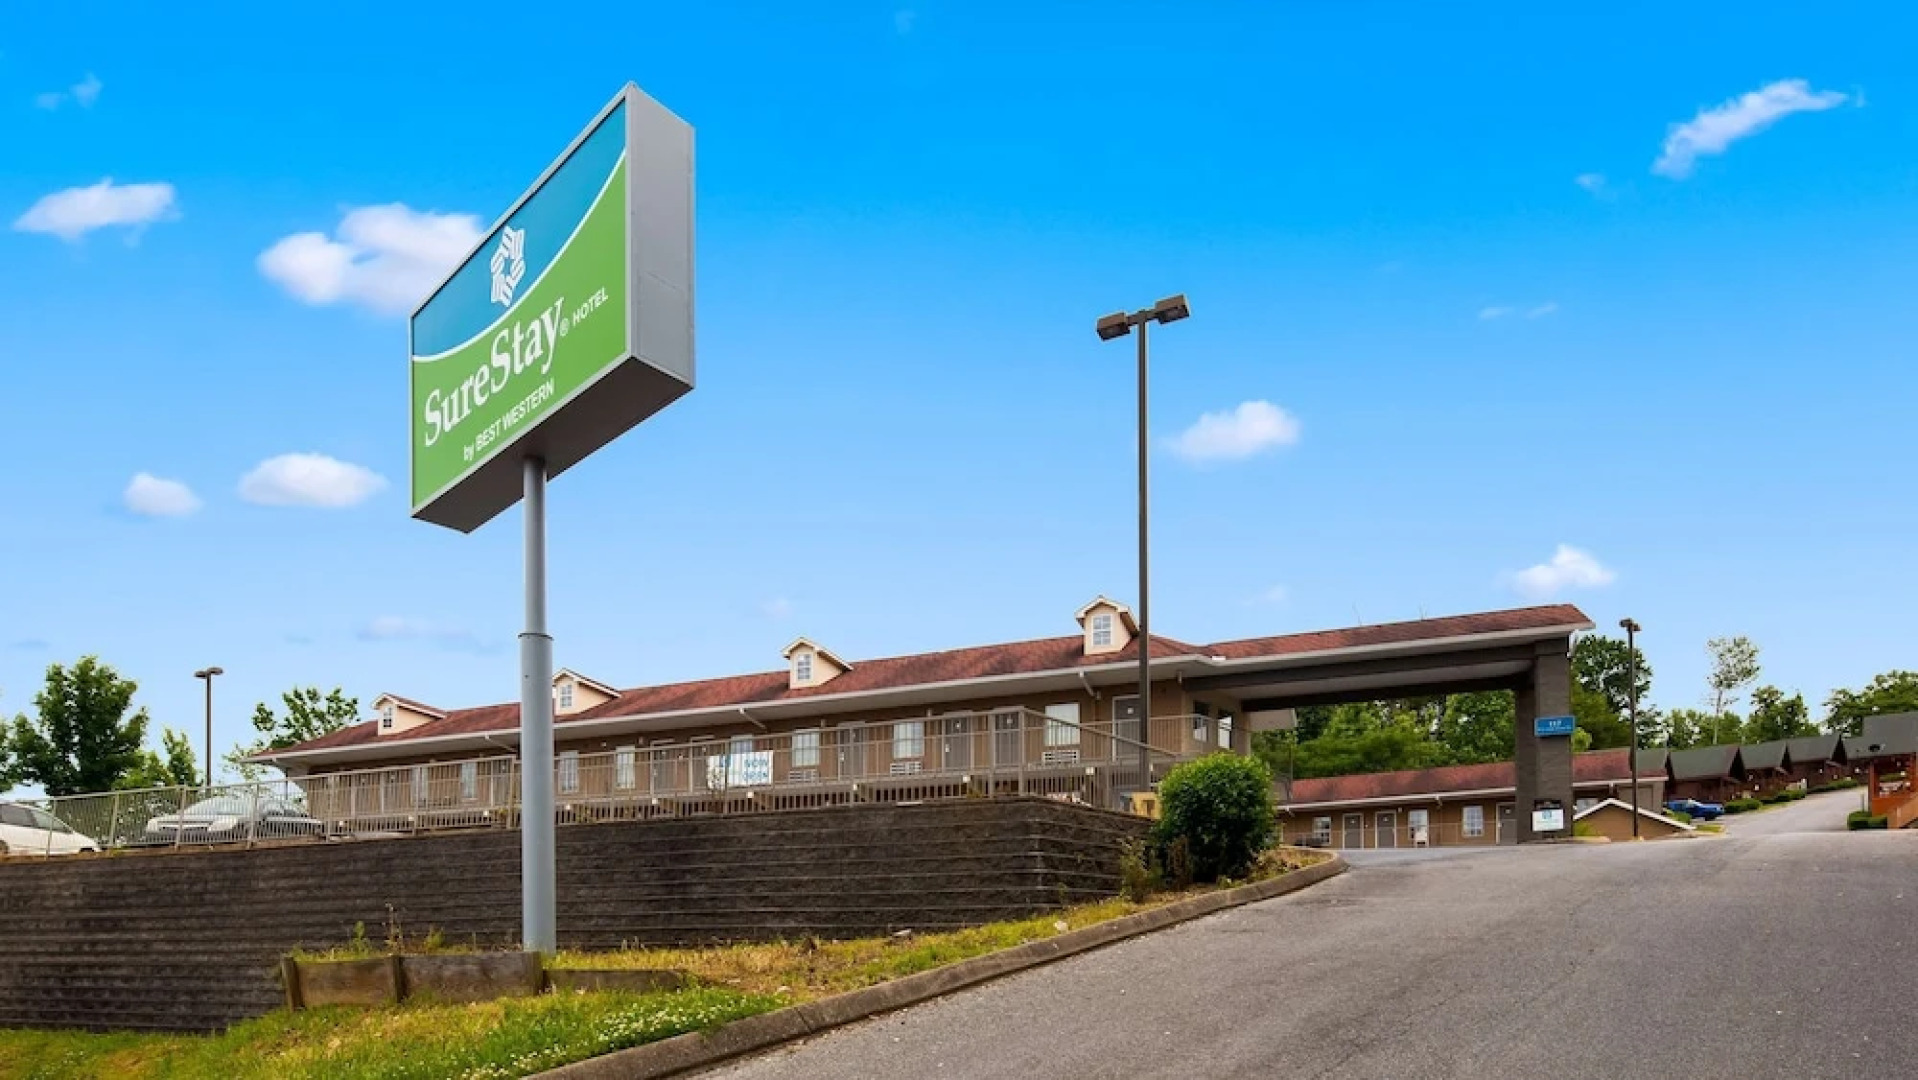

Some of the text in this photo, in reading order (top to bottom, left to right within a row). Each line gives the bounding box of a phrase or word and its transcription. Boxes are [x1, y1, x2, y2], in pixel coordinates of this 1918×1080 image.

[572, 286, 609, 328] HOTEL
[463, 378, 555, 461] by BEST WESTERN
